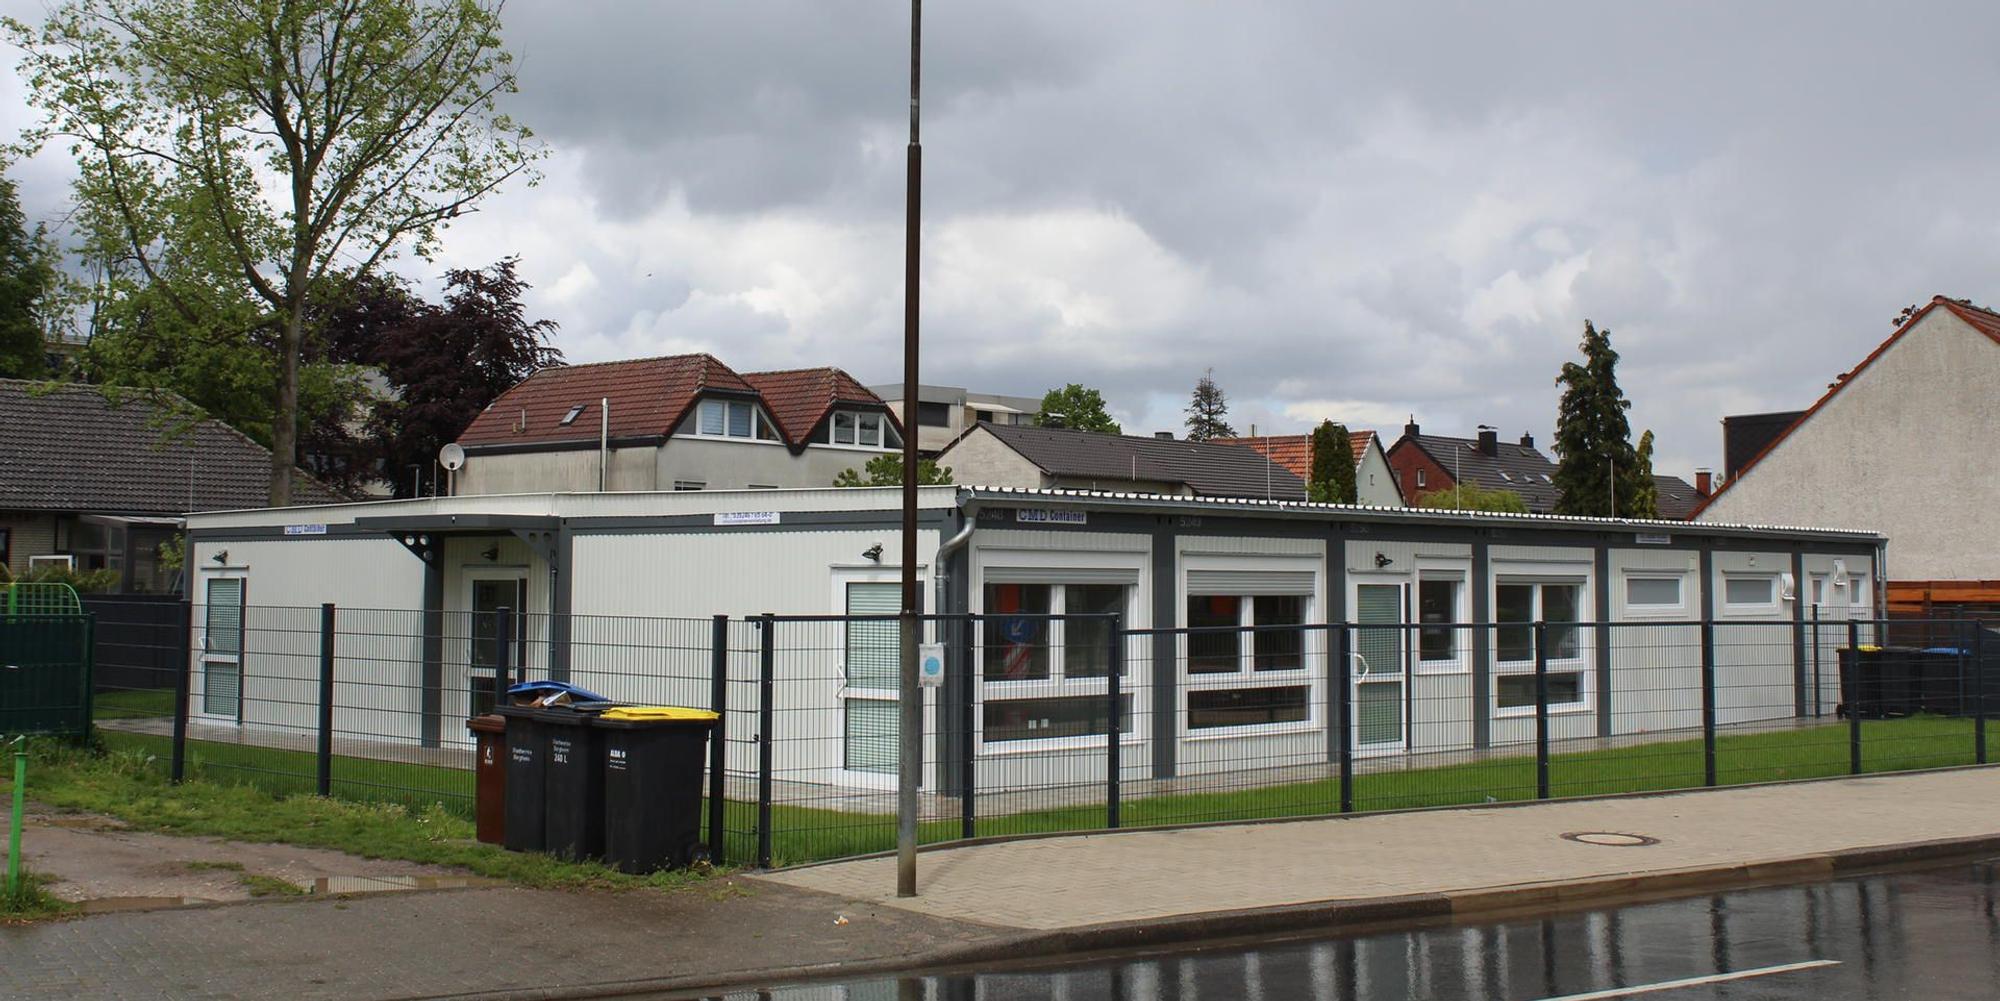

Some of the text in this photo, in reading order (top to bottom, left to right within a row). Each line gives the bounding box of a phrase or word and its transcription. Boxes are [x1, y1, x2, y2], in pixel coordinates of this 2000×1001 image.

[1019, 509, 1085, 522] CMD Container
[564, 754, 568, 764] L
